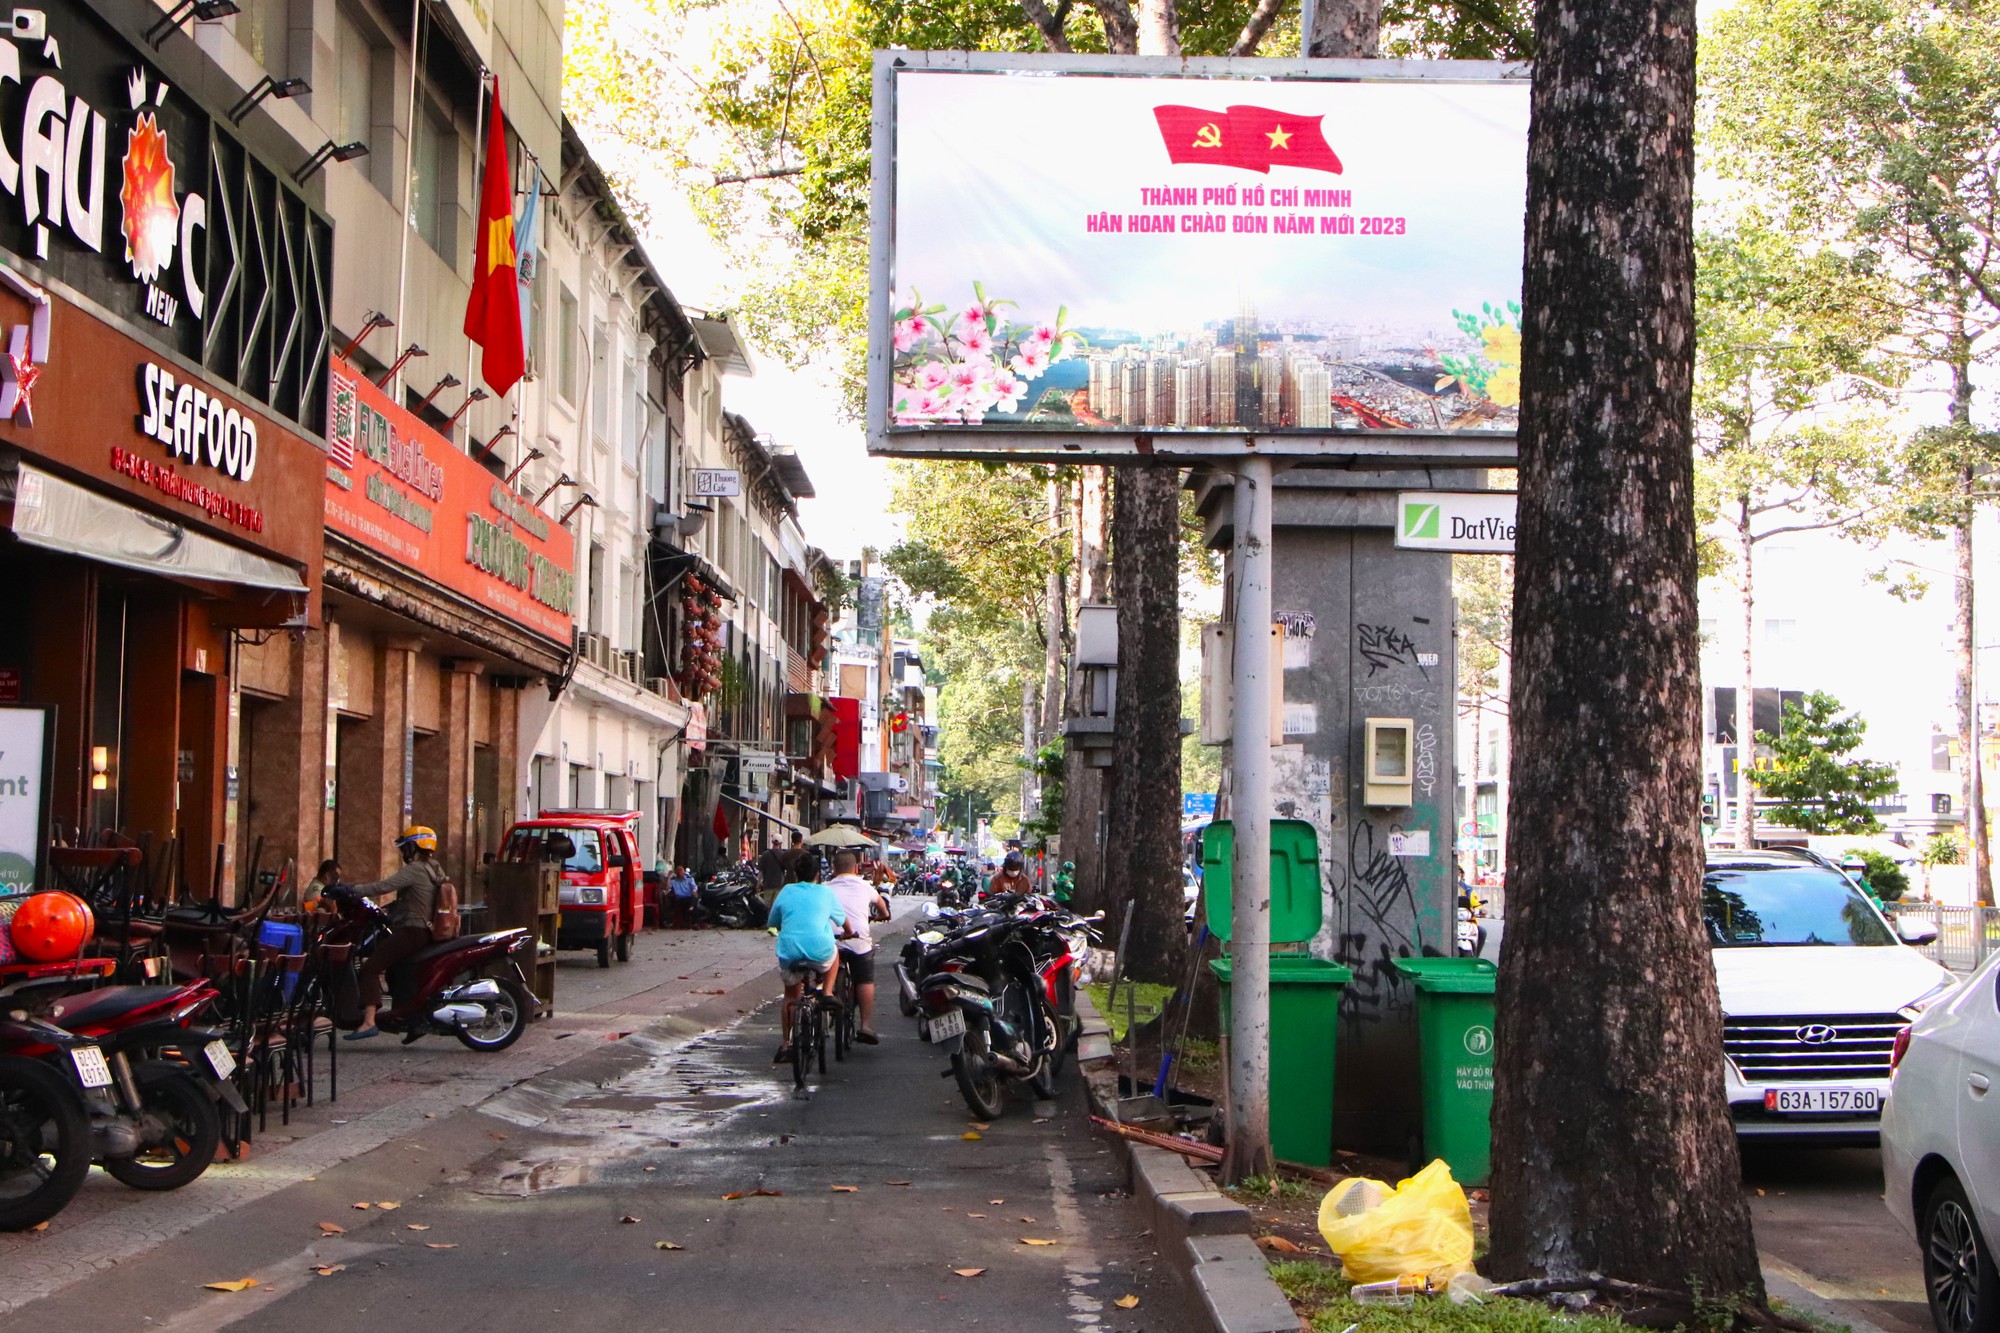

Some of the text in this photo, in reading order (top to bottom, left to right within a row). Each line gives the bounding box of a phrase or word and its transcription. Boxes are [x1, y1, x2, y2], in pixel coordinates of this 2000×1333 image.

[1140, 182, 1352, 207] THÀNH PHỐ HỒ CHÍ MINH
[1087, 211, 1407, 235] HÂN HOAN CHÀO ĐÓN NĂM MỚI 2023
[145, 283, 178, 327] NEW
[143, 362, 257, 482] SEAFOOD
[357, 401, 388, 464] FUTA
[1780, 1091, 1875, 1109] 63A-157.60
